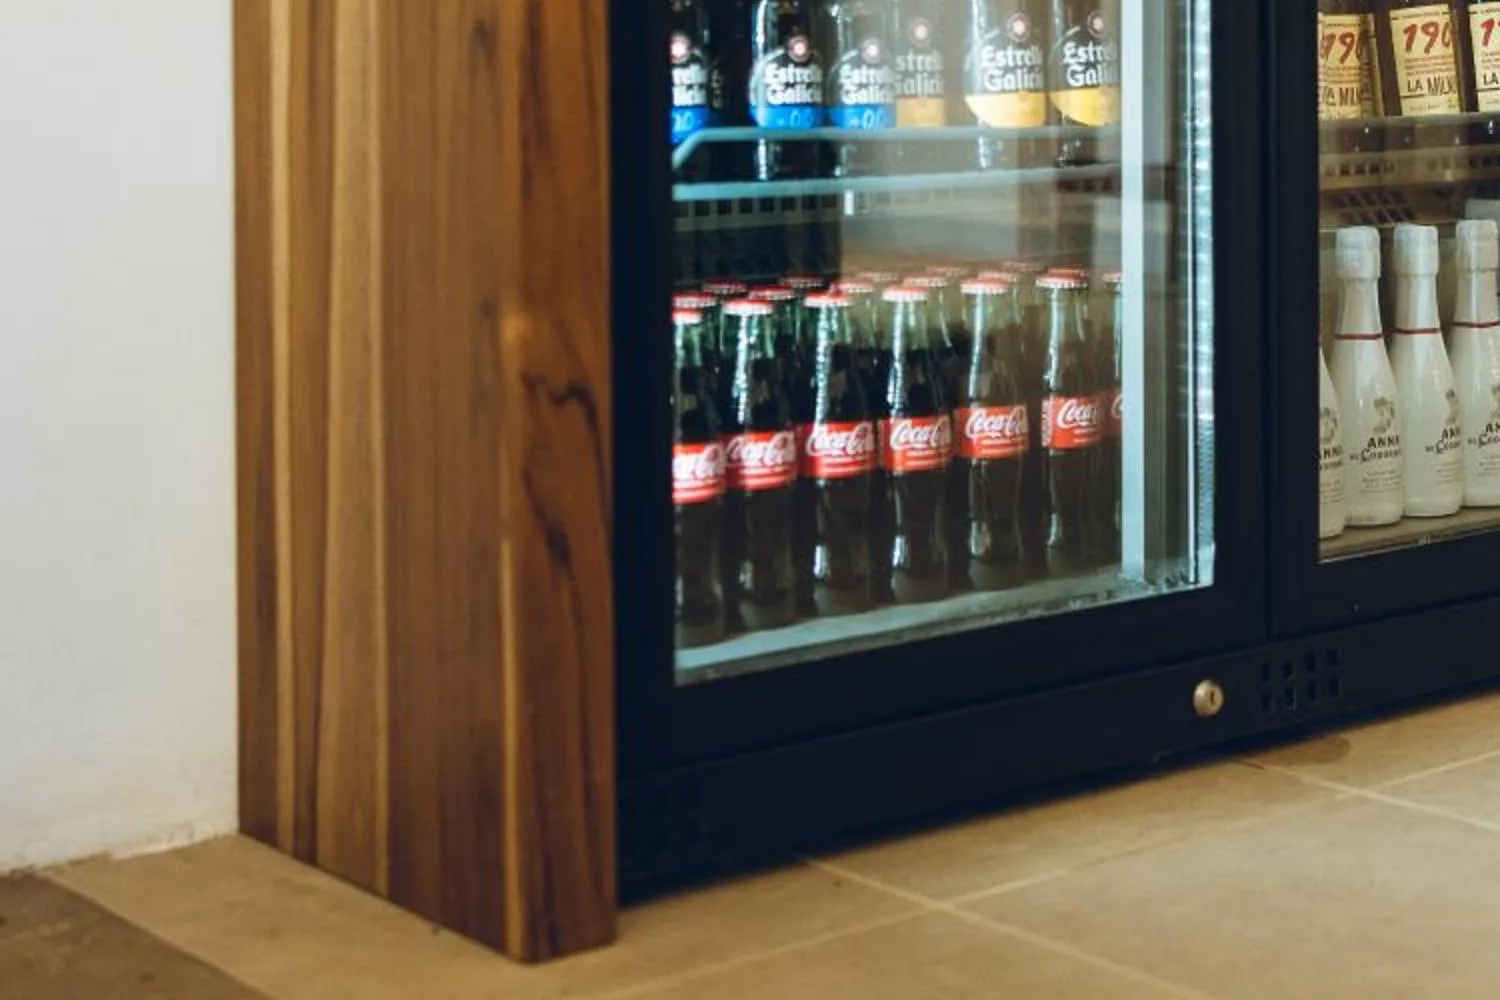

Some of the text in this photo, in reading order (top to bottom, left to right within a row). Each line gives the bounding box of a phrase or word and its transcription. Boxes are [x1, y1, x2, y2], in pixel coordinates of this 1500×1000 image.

[981, 45, 1042, 67] Estrell
[984, 66, 1043, 91] Galici
[1483, 72, 1499, 86] LA
